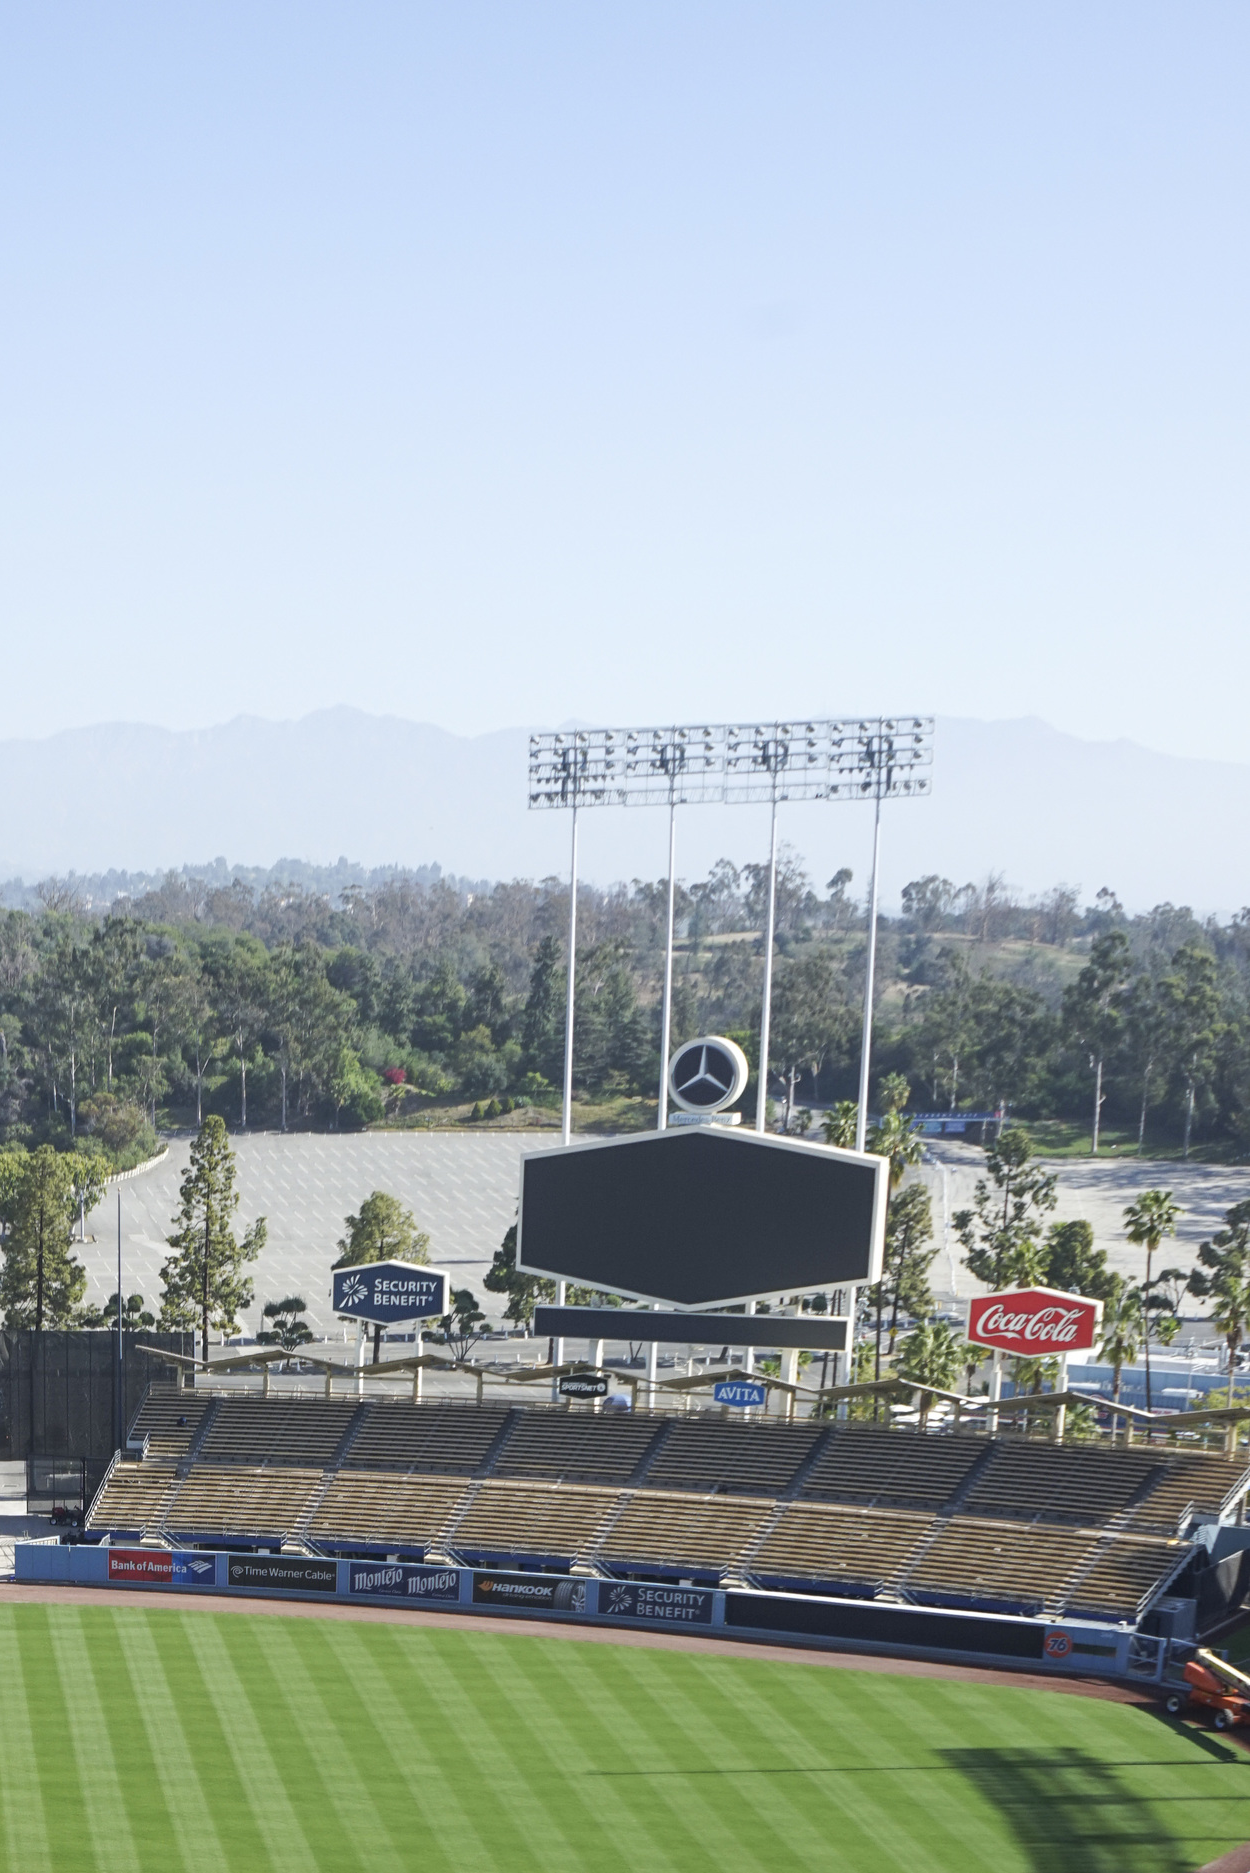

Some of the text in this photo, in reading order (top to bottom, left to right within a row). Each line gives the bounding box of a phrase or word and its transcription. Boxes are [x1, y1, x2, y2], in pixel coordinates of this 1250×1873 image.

[374, 1279, 437, 1293] SECURITY
[976, 1304, 1086, 1343] Coca-Cola
[717, 1386, 760, 1402] AVITA
[111, 1560, 187, 1574] Bank of America
[244, 1565, 270, 1576] Time
[269, 1567, 304, 1579] Warner
[638, 1588, 705, 1606] SECURITY
[1047, 1637, 1069, 1652] 76
